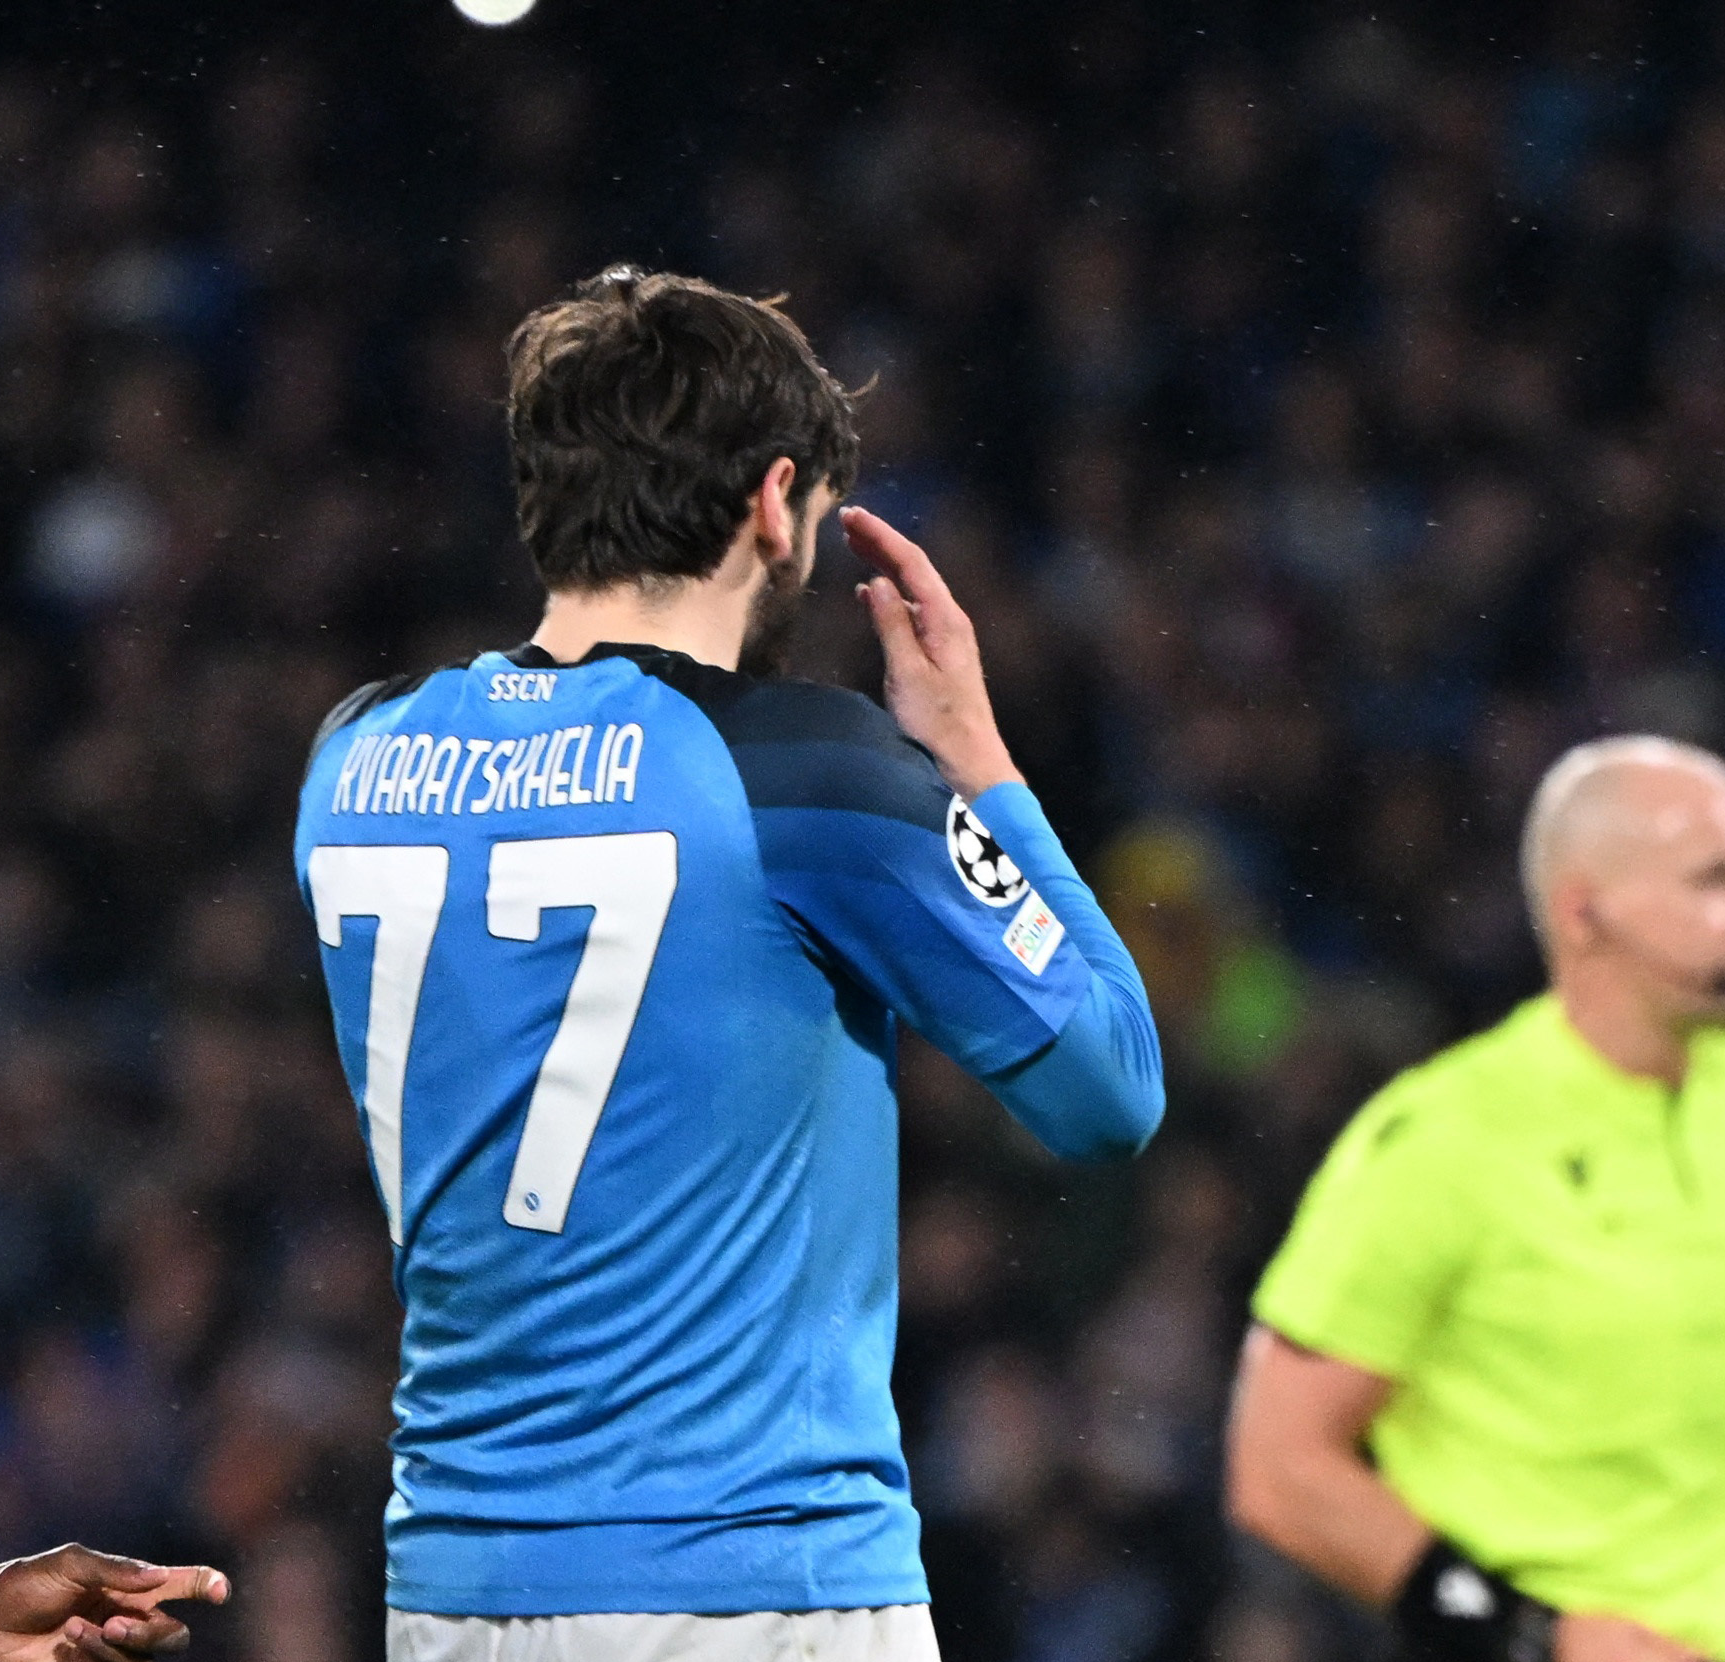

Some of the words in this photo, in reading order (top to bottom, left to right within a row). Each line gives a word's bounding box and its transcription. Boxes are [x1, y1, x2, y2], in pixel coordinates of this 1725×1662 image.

[488, 673, 558, 703] SSCN
[331, 723, 645, 816] KVARATSKHELIA
[306, 831, 677, 1246] 77
